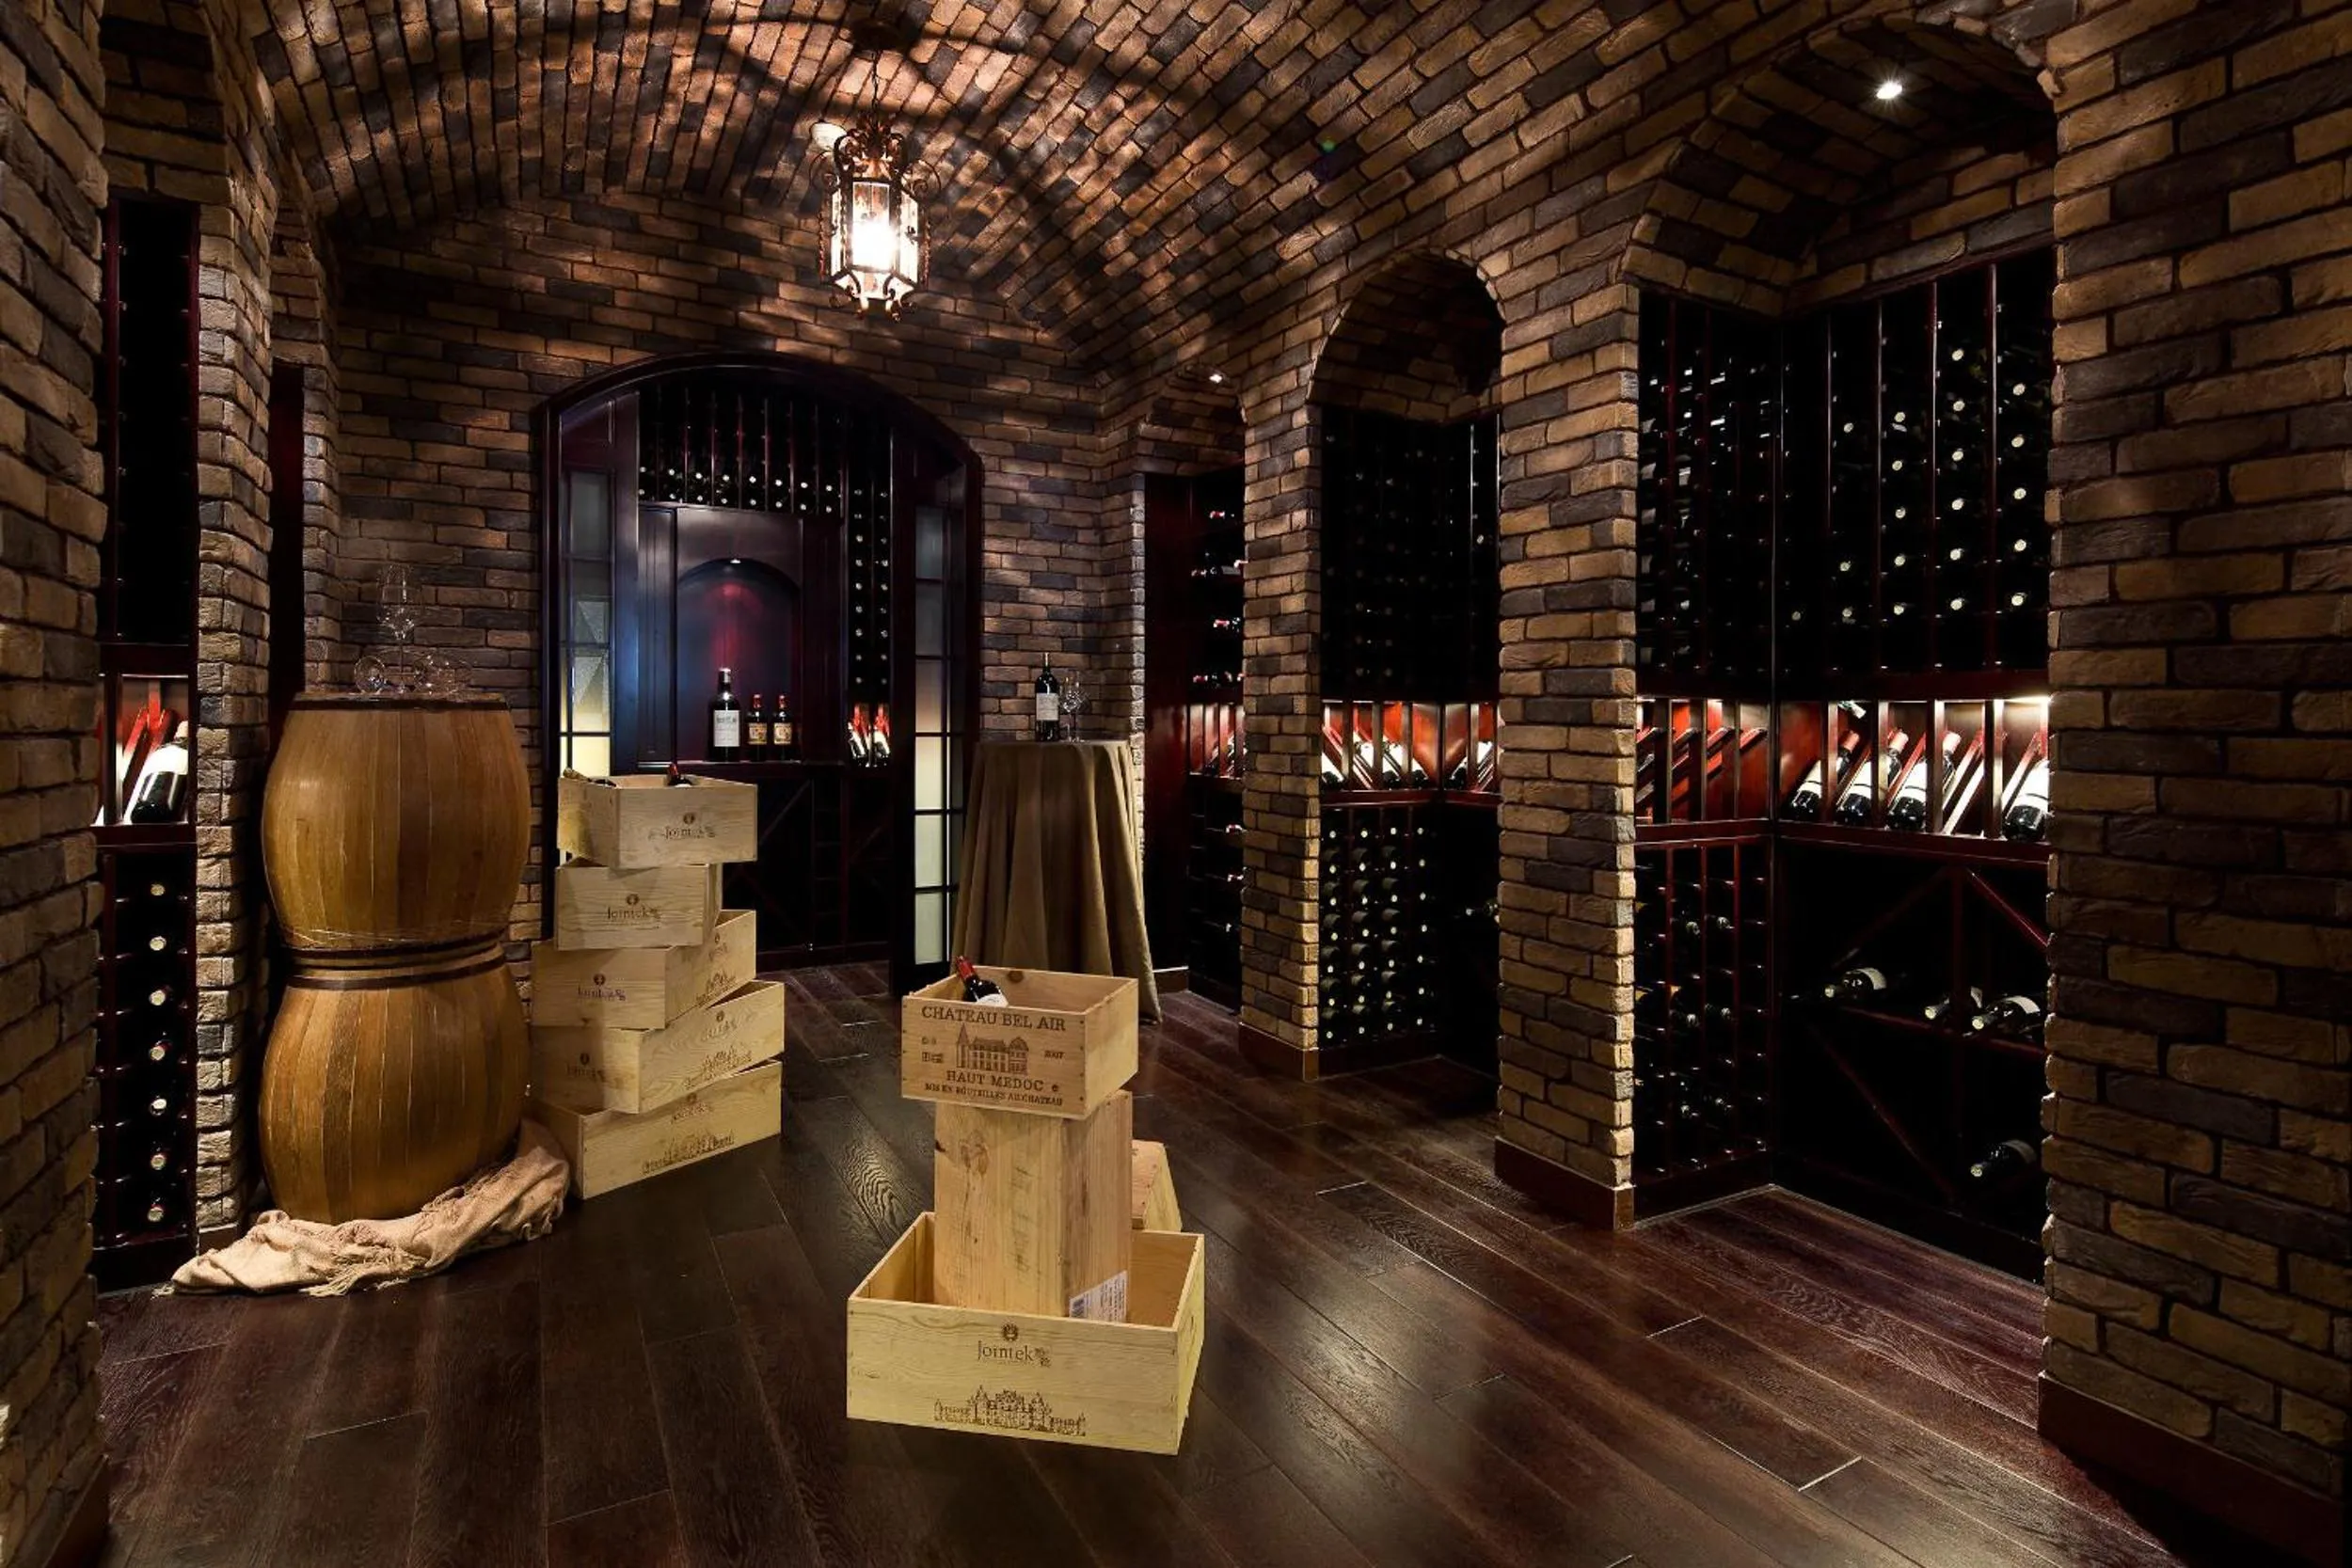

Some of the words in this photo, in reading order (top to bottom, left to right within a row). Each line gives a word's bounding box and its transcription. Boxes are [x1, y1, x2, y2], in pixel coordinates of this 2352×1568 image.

[921, 1006, 998, 1025] CHATEAU
[1001, 1013, 1033, 1029] BEL
[1036, 1016, 1067, 1032] AIR
[946, 1069, 986, 1085] HAUT
[990, 1074, 1044, 1092] MEDOC
[977, 1340, 1034, 1362] Jointek
